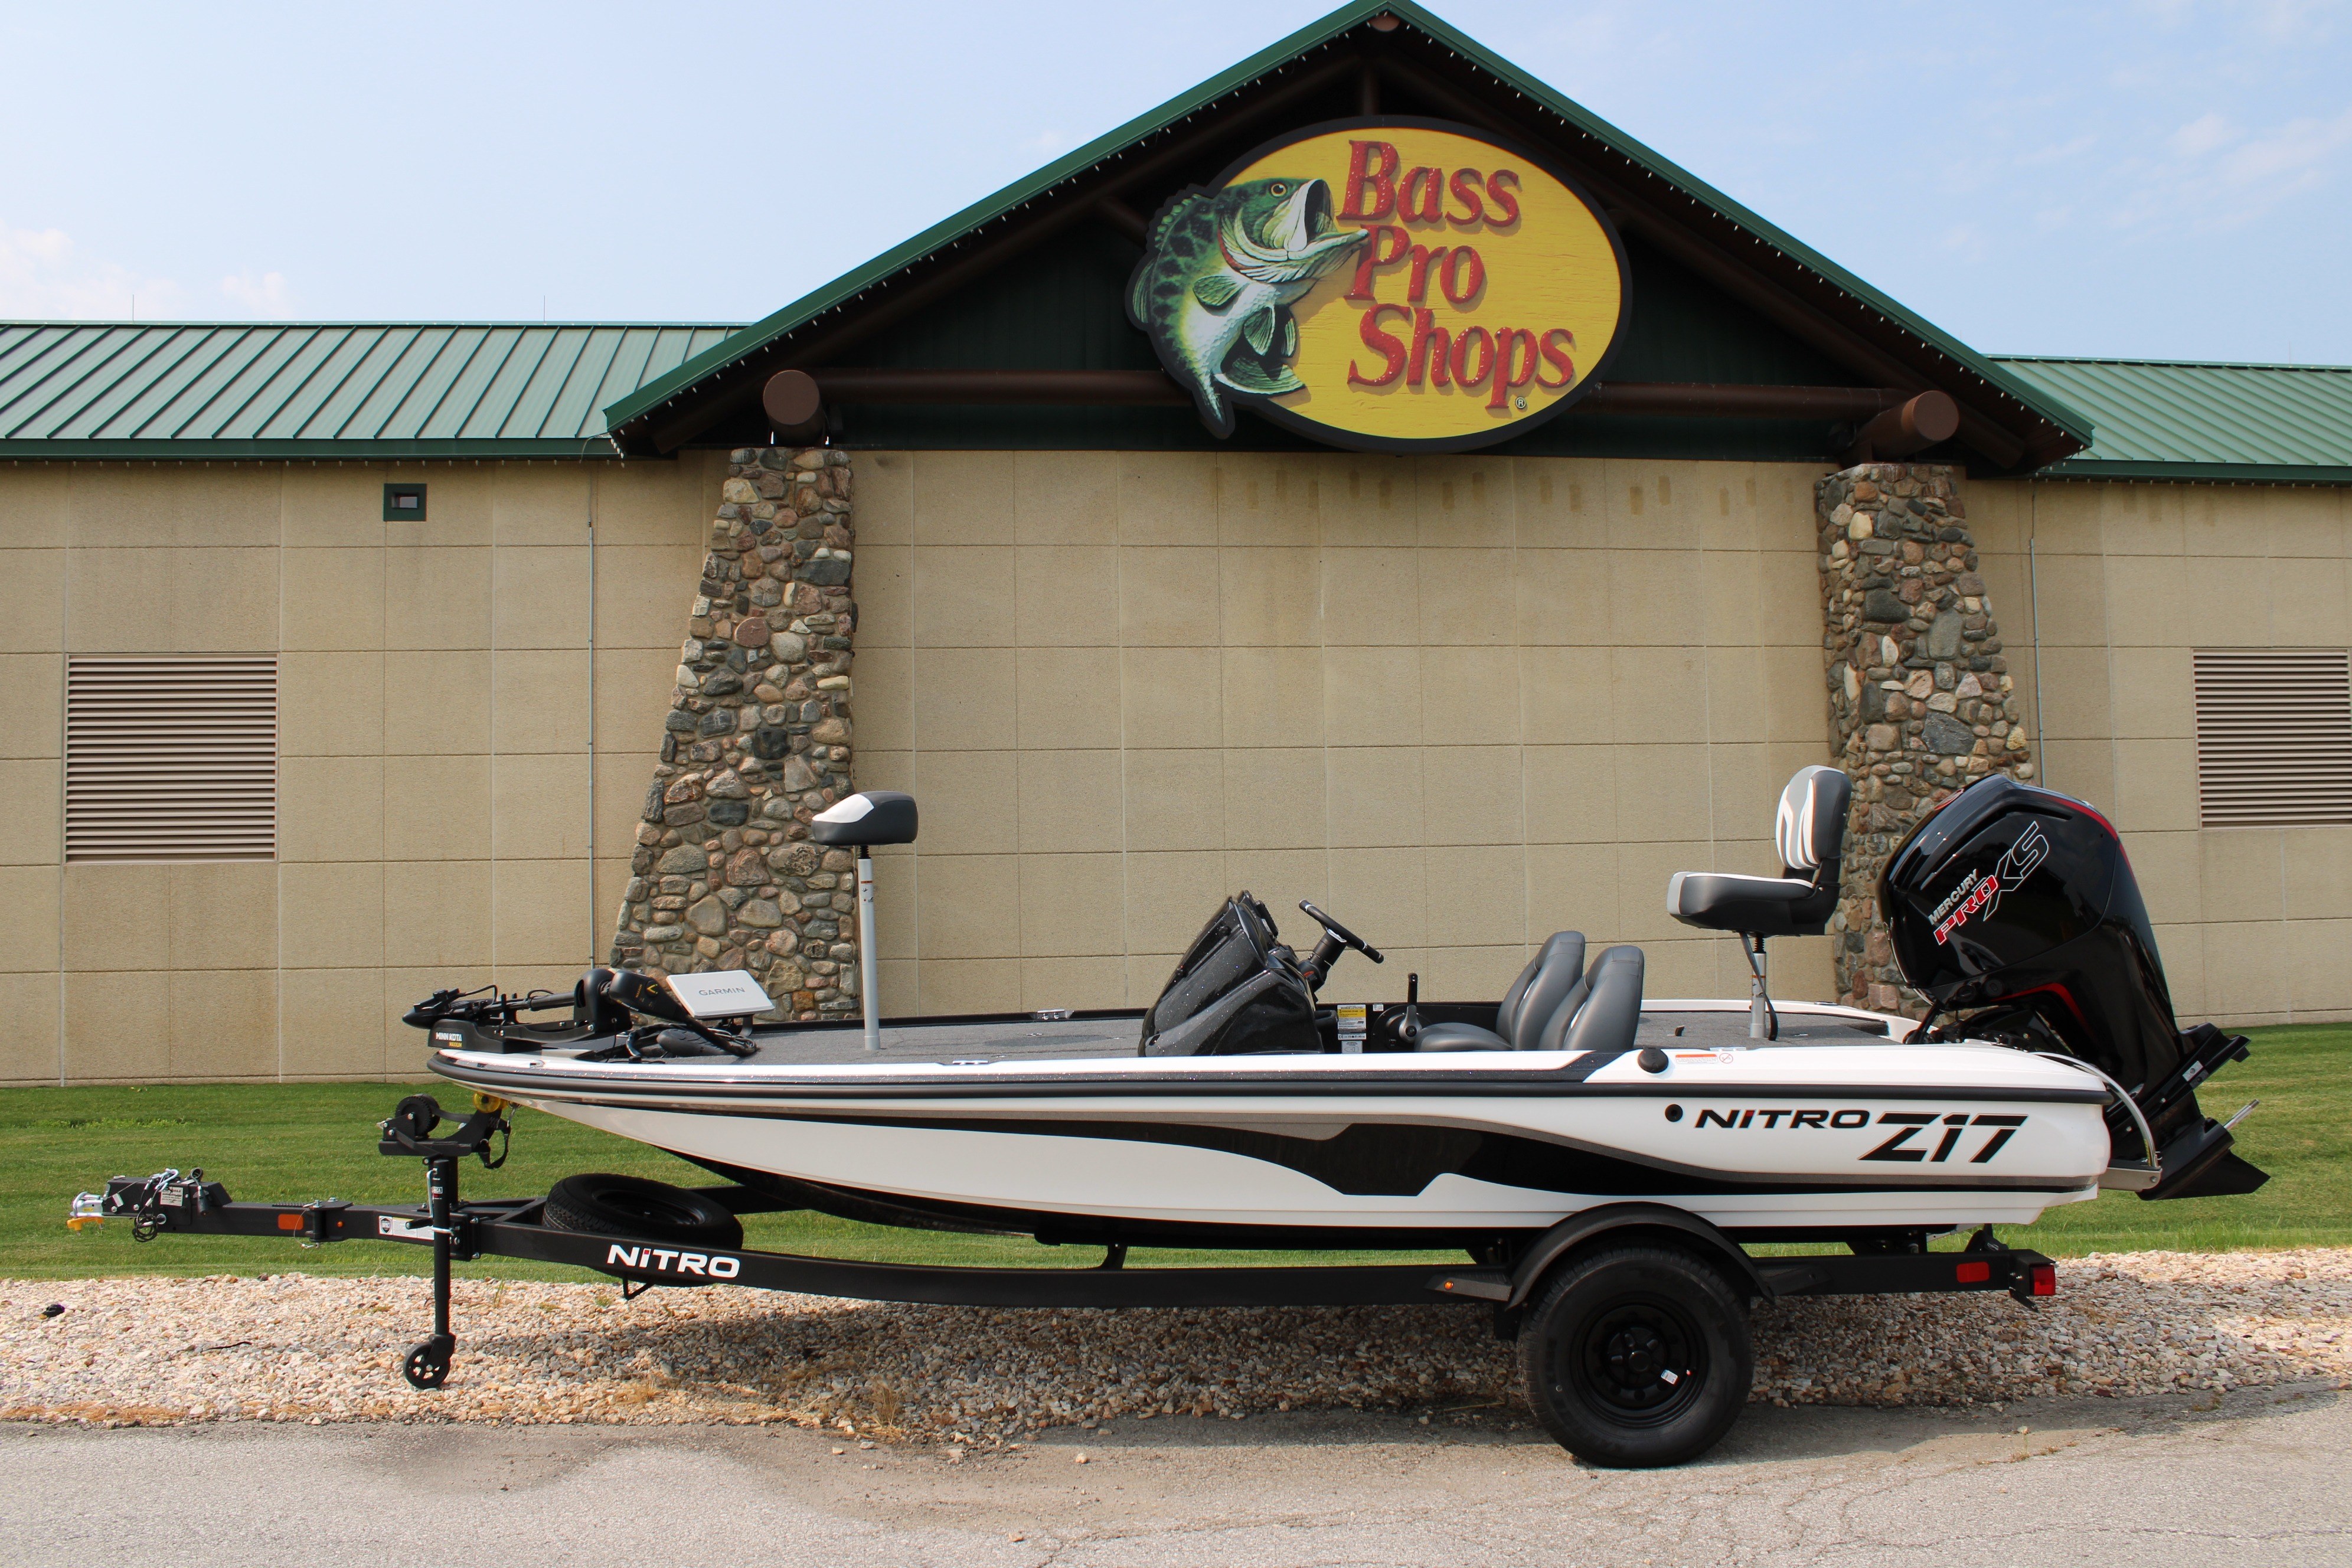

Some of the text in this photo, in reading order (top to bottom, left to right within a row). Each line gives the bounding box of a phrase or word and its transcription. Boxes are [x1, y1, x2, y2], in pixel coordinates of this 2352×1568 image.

[1336, 139, 1519, 227] Bass
[1344, 224, 1485, 305] Pro
[1347, 303, 1574, 409] Shops
[1928, 868, 1978, 925] MERCURY
[1933, 821, 2049, 945] PRO XS
[698, 986, 746, 996] GARMIN
[436, 1032, 462, 1042] MINN KOTA
[1694, 1109, 2029, 1164] NITRO Z17
